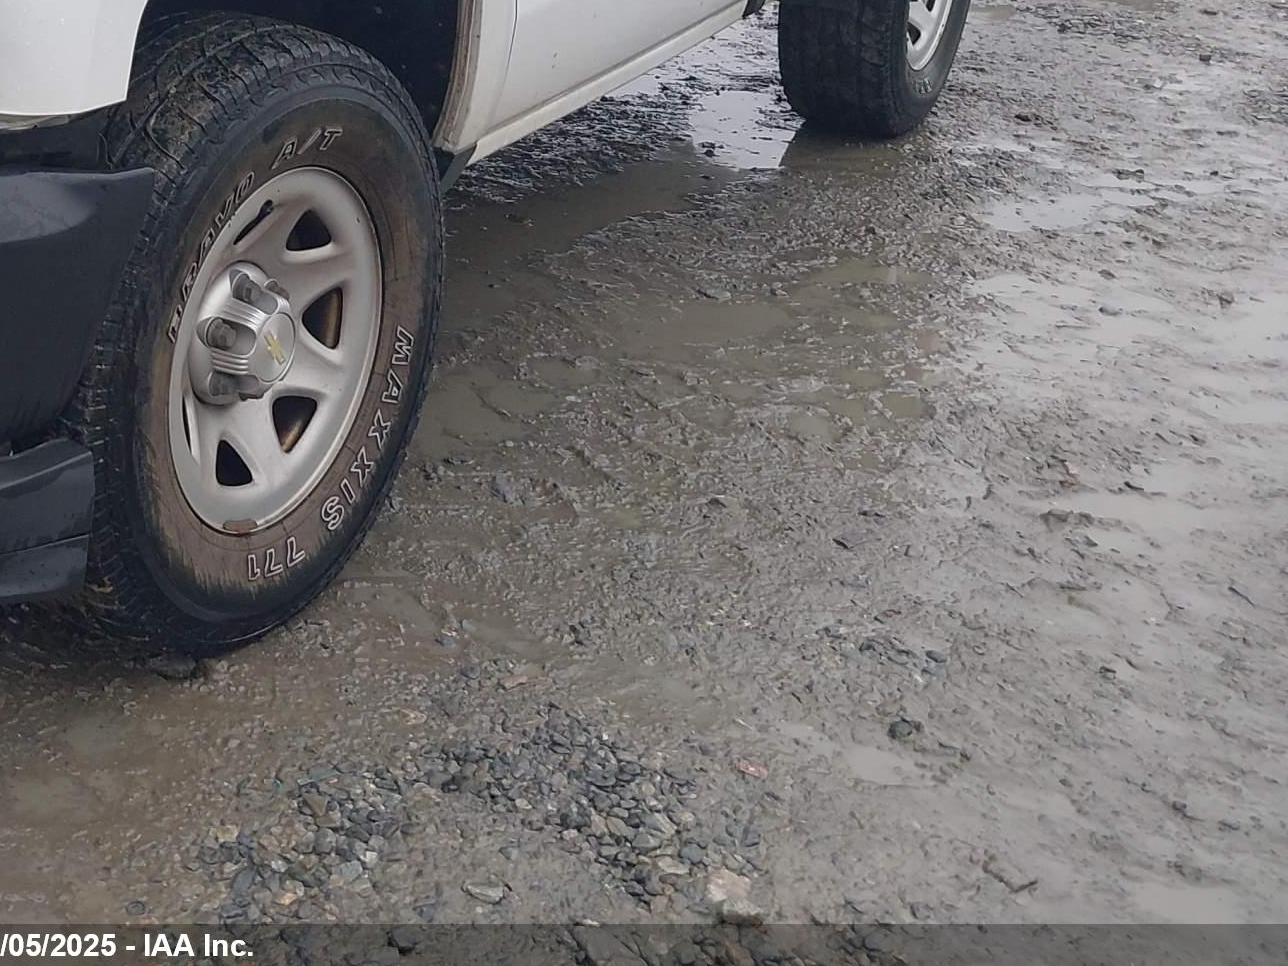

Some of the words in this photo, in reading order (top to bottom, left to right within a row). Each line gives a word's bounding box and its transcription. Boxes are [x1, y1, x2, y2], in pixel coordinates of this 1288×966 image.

[271, 127, 344, 170] A/T
[322, 325, 415, 531] MAXXIS
[247, 536, 306, 582] 771
